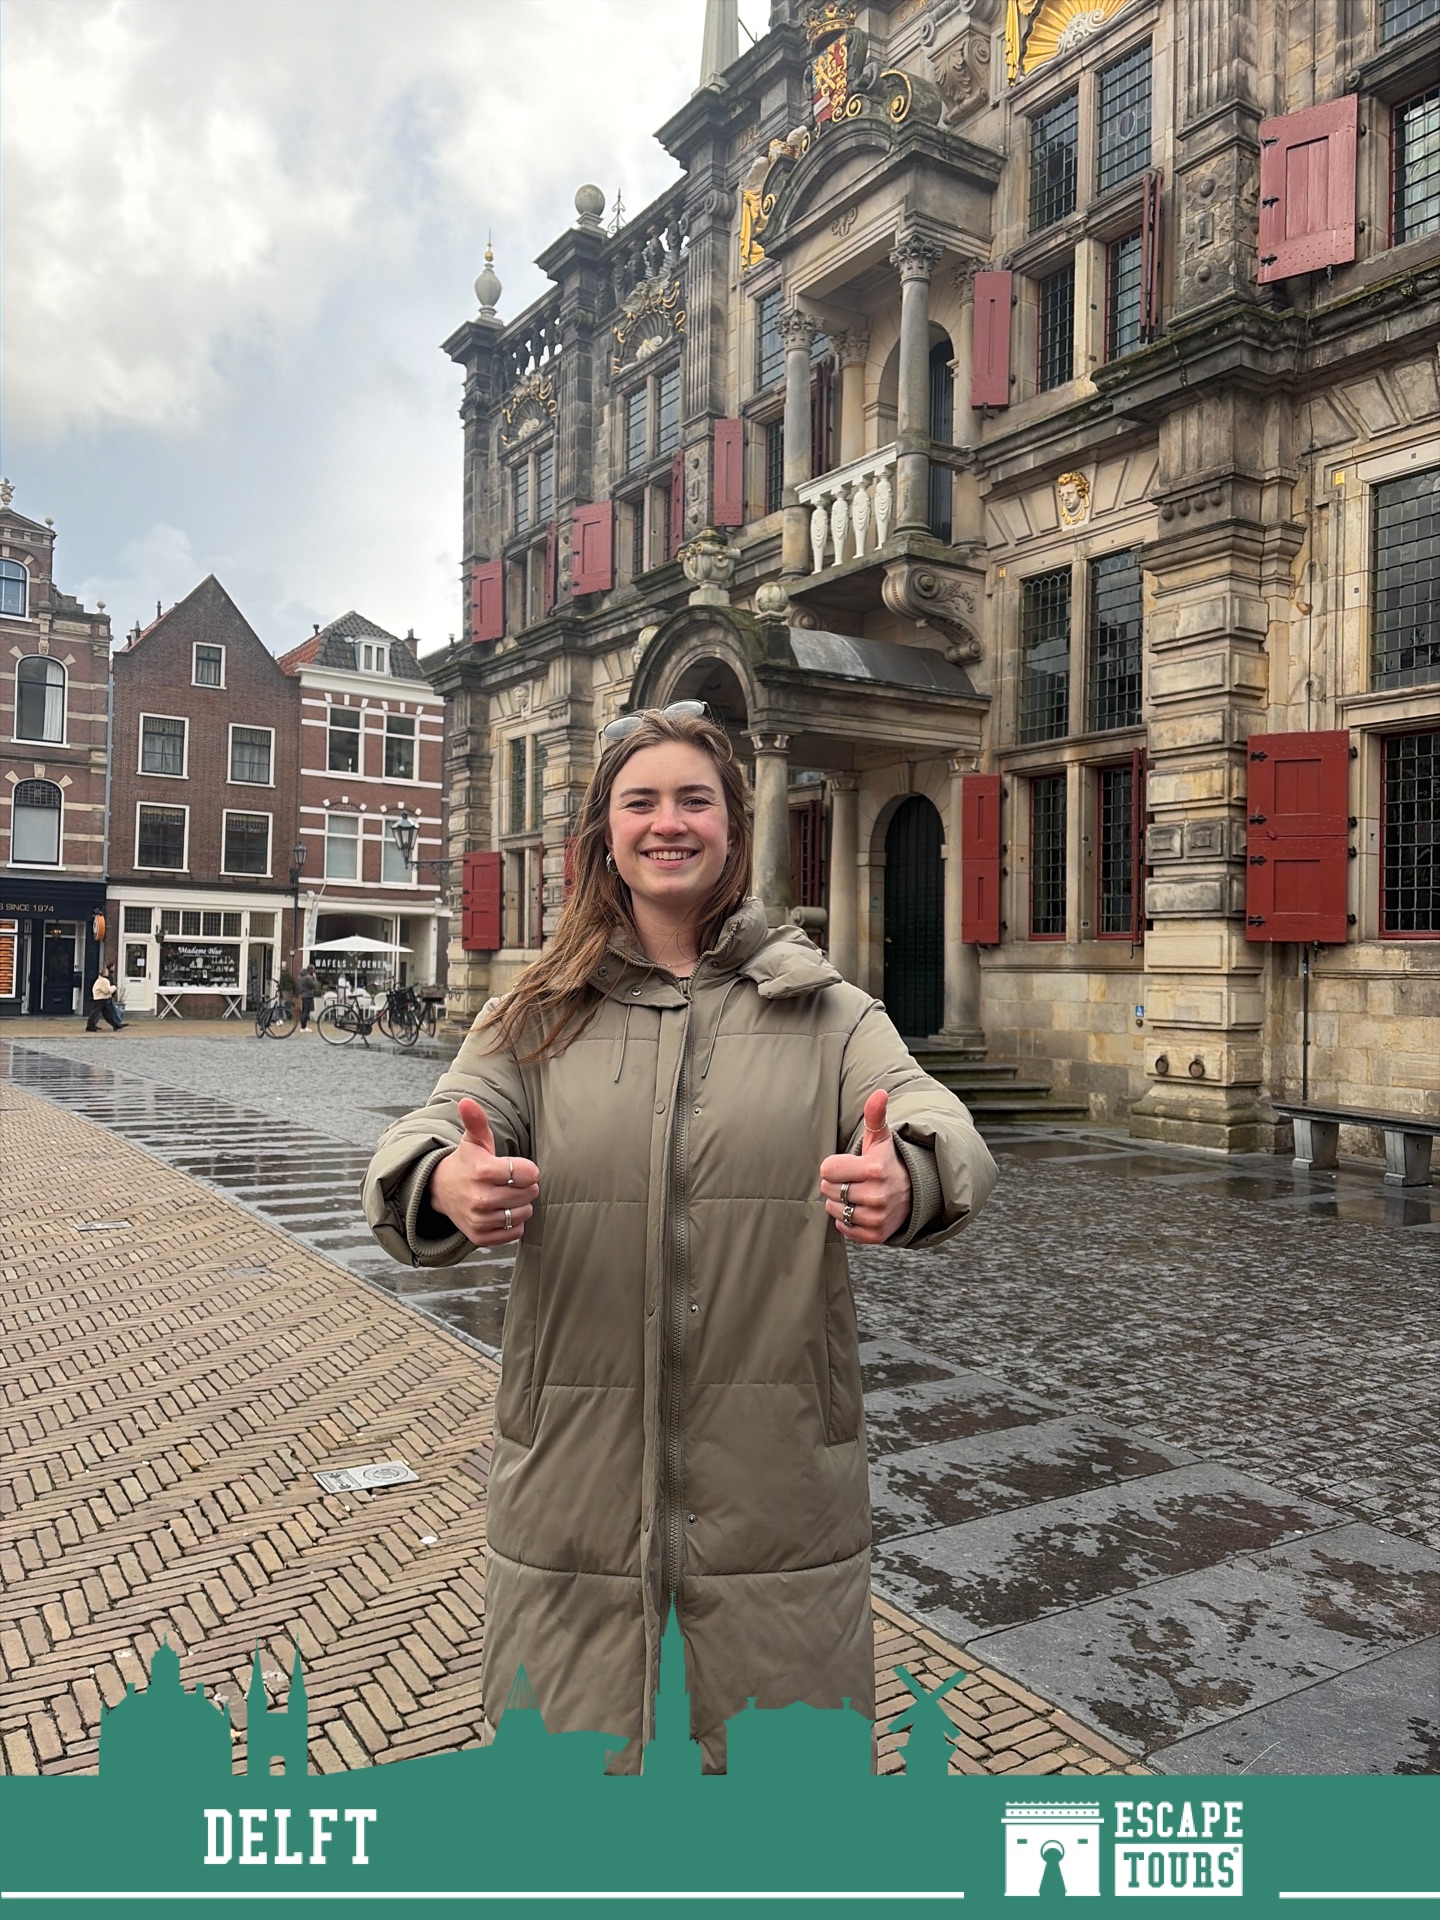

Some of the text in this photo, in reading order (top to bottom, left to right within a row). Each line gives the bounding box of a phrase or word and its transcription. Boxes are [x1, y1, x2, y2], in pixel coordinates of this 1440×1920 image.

[6, 903, 30, 912] SINCE
[33, 904, 54, 913] 1974
[178, 945, 207, 955] Madame
[315, 959, 347, 969] WAFELS
